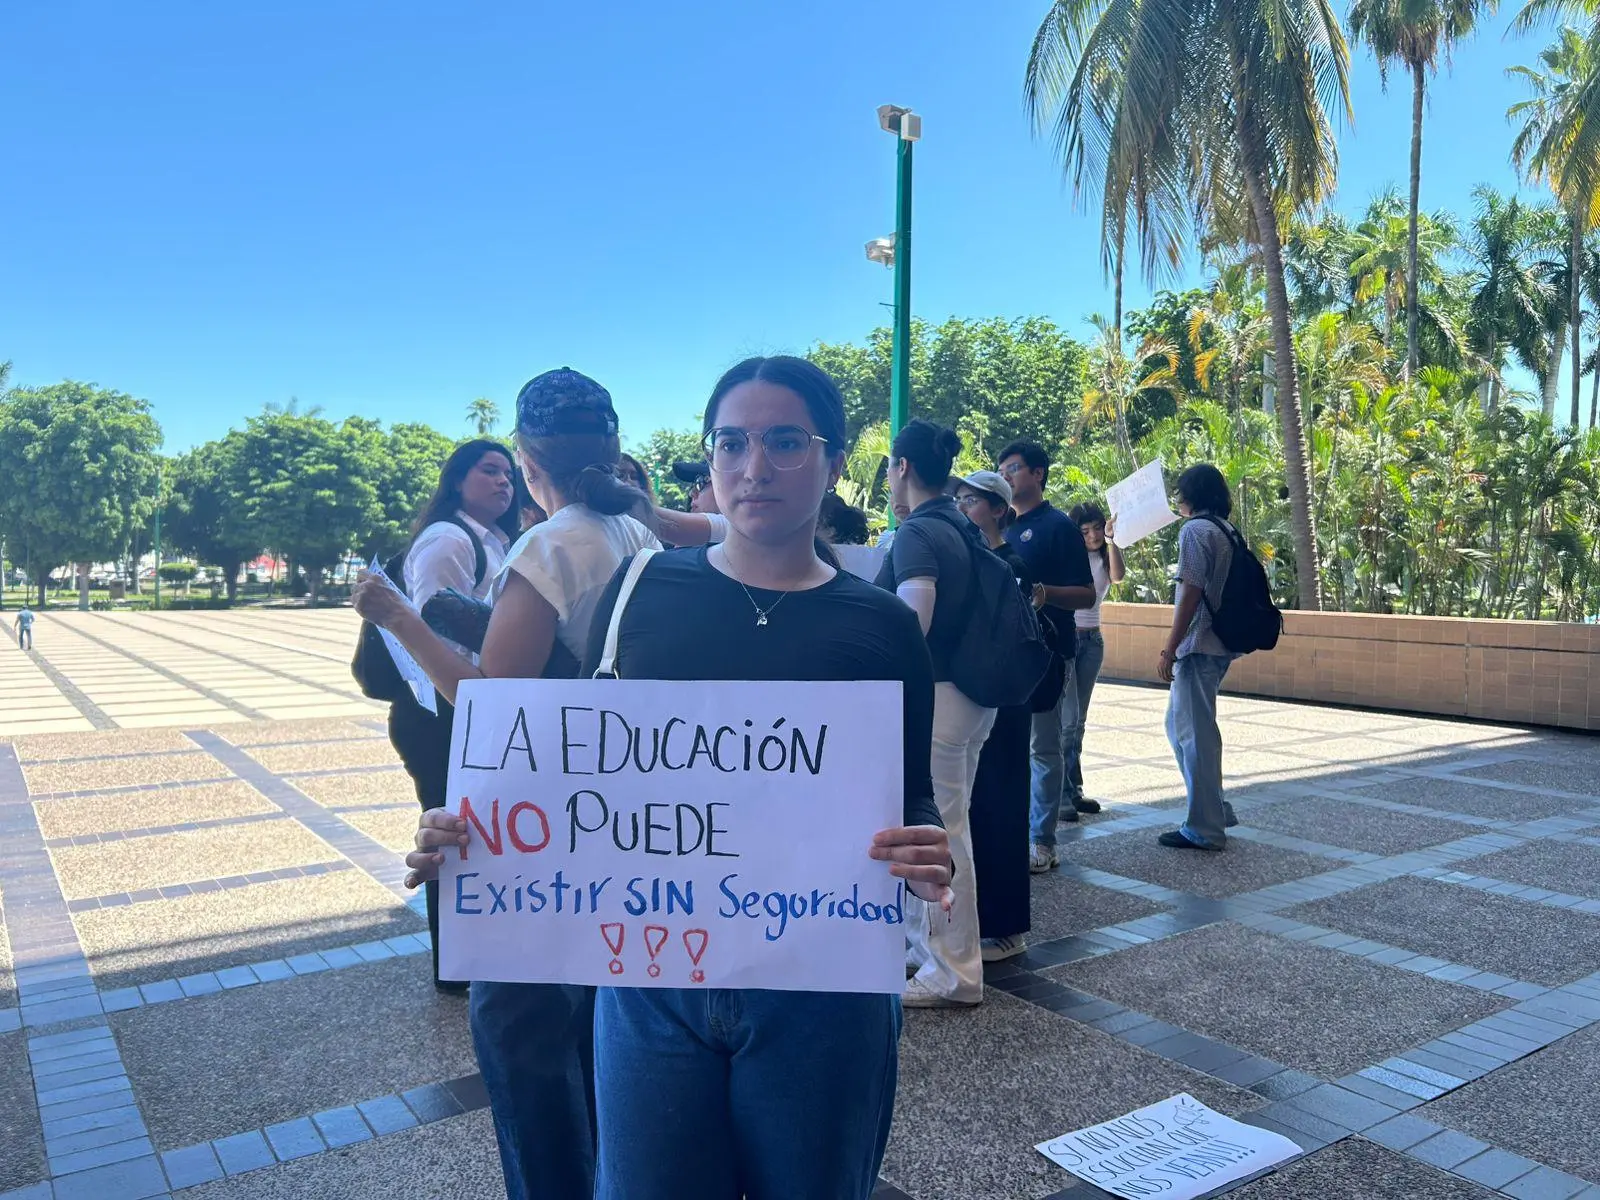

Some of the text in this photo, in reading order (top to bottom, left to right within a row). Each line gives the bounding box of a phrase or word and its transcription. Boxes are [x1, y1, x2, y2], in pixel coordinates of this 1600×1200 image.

[461, 700, 537, 772] LA
[458, 790, 740, 861] NO PUEDE
[455, 871, 904, 942] Existir SIN Seguridad
[1047, 1113, 1165, 1167] SI NO NOS
[1076, 1124, 1220, 1184] ESCUCHAN QUE
[1111, 1175, 1173, 1200] NOS
